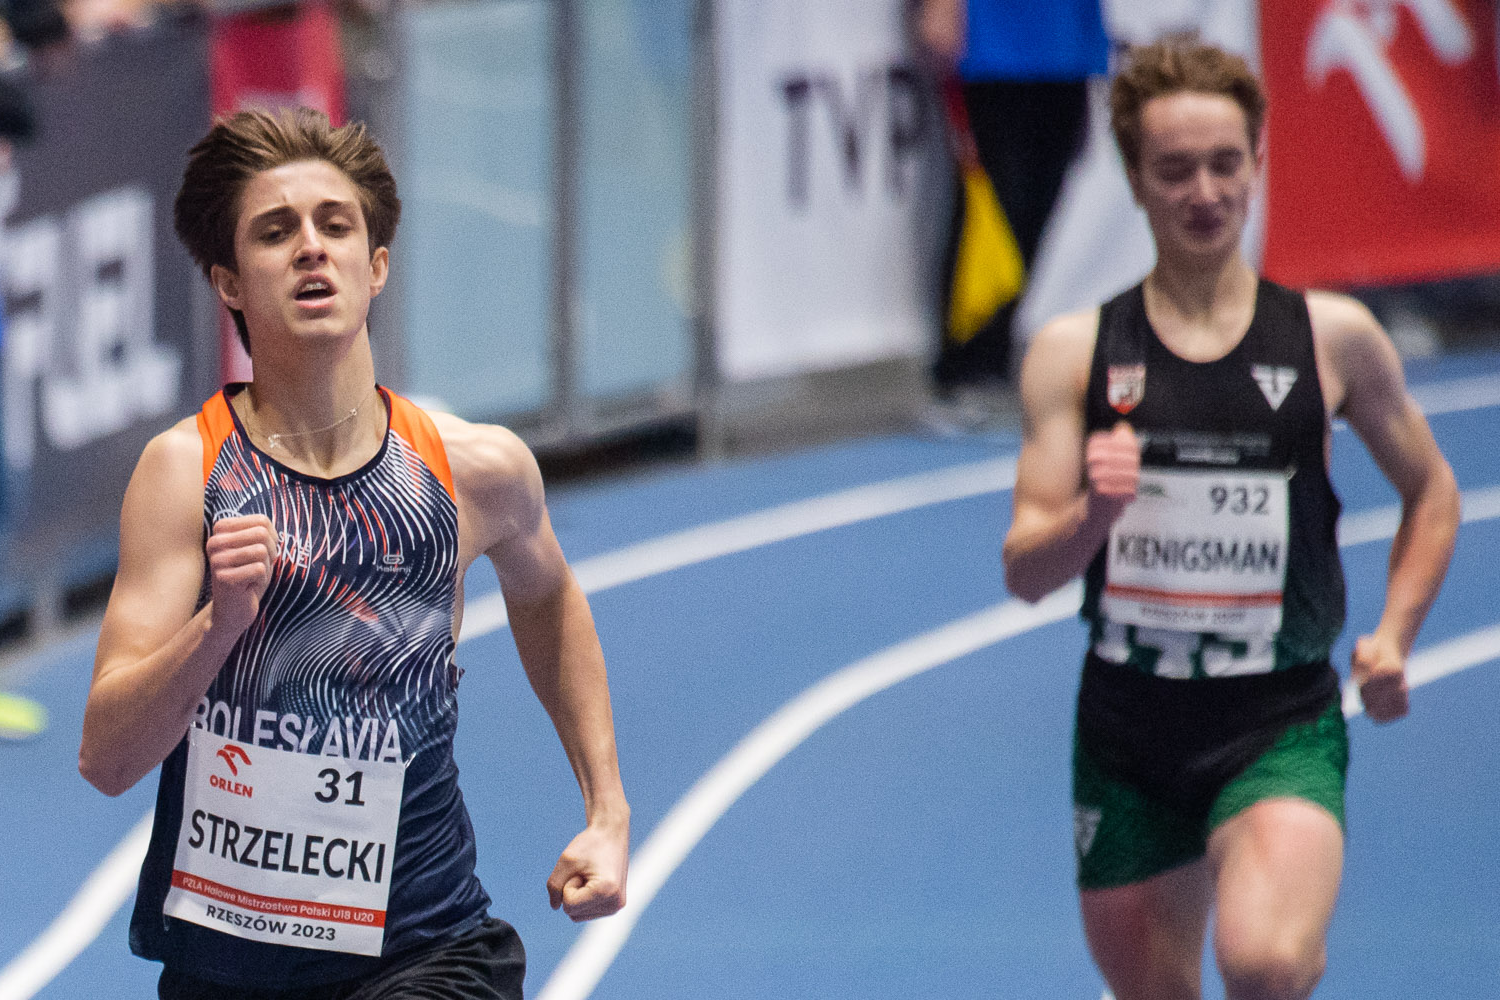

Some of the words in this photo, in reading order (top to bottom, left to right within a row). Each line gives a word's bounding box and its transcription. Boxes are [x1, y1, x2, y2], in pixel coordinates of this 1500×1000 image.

[1210, 483, 1270, 517] 932
[209, 774, 254, 799] ORLEN
[314, 767, 366, 807] 31
[188, 809, 387, 884] STRZELECKI
[182, 877, 203, 891] PZLA
[204, 884, 236, 902] Halowe
[237, 894, 298, 914] Mistrzostwa
[300, 906, 331, 918] Polski
[332, 910, 351, 920] U18
[353, 912, 375, 923] U20
[206, 904, 287, 935] RZESZÓW
[291, 922, 336, 942] 2023
